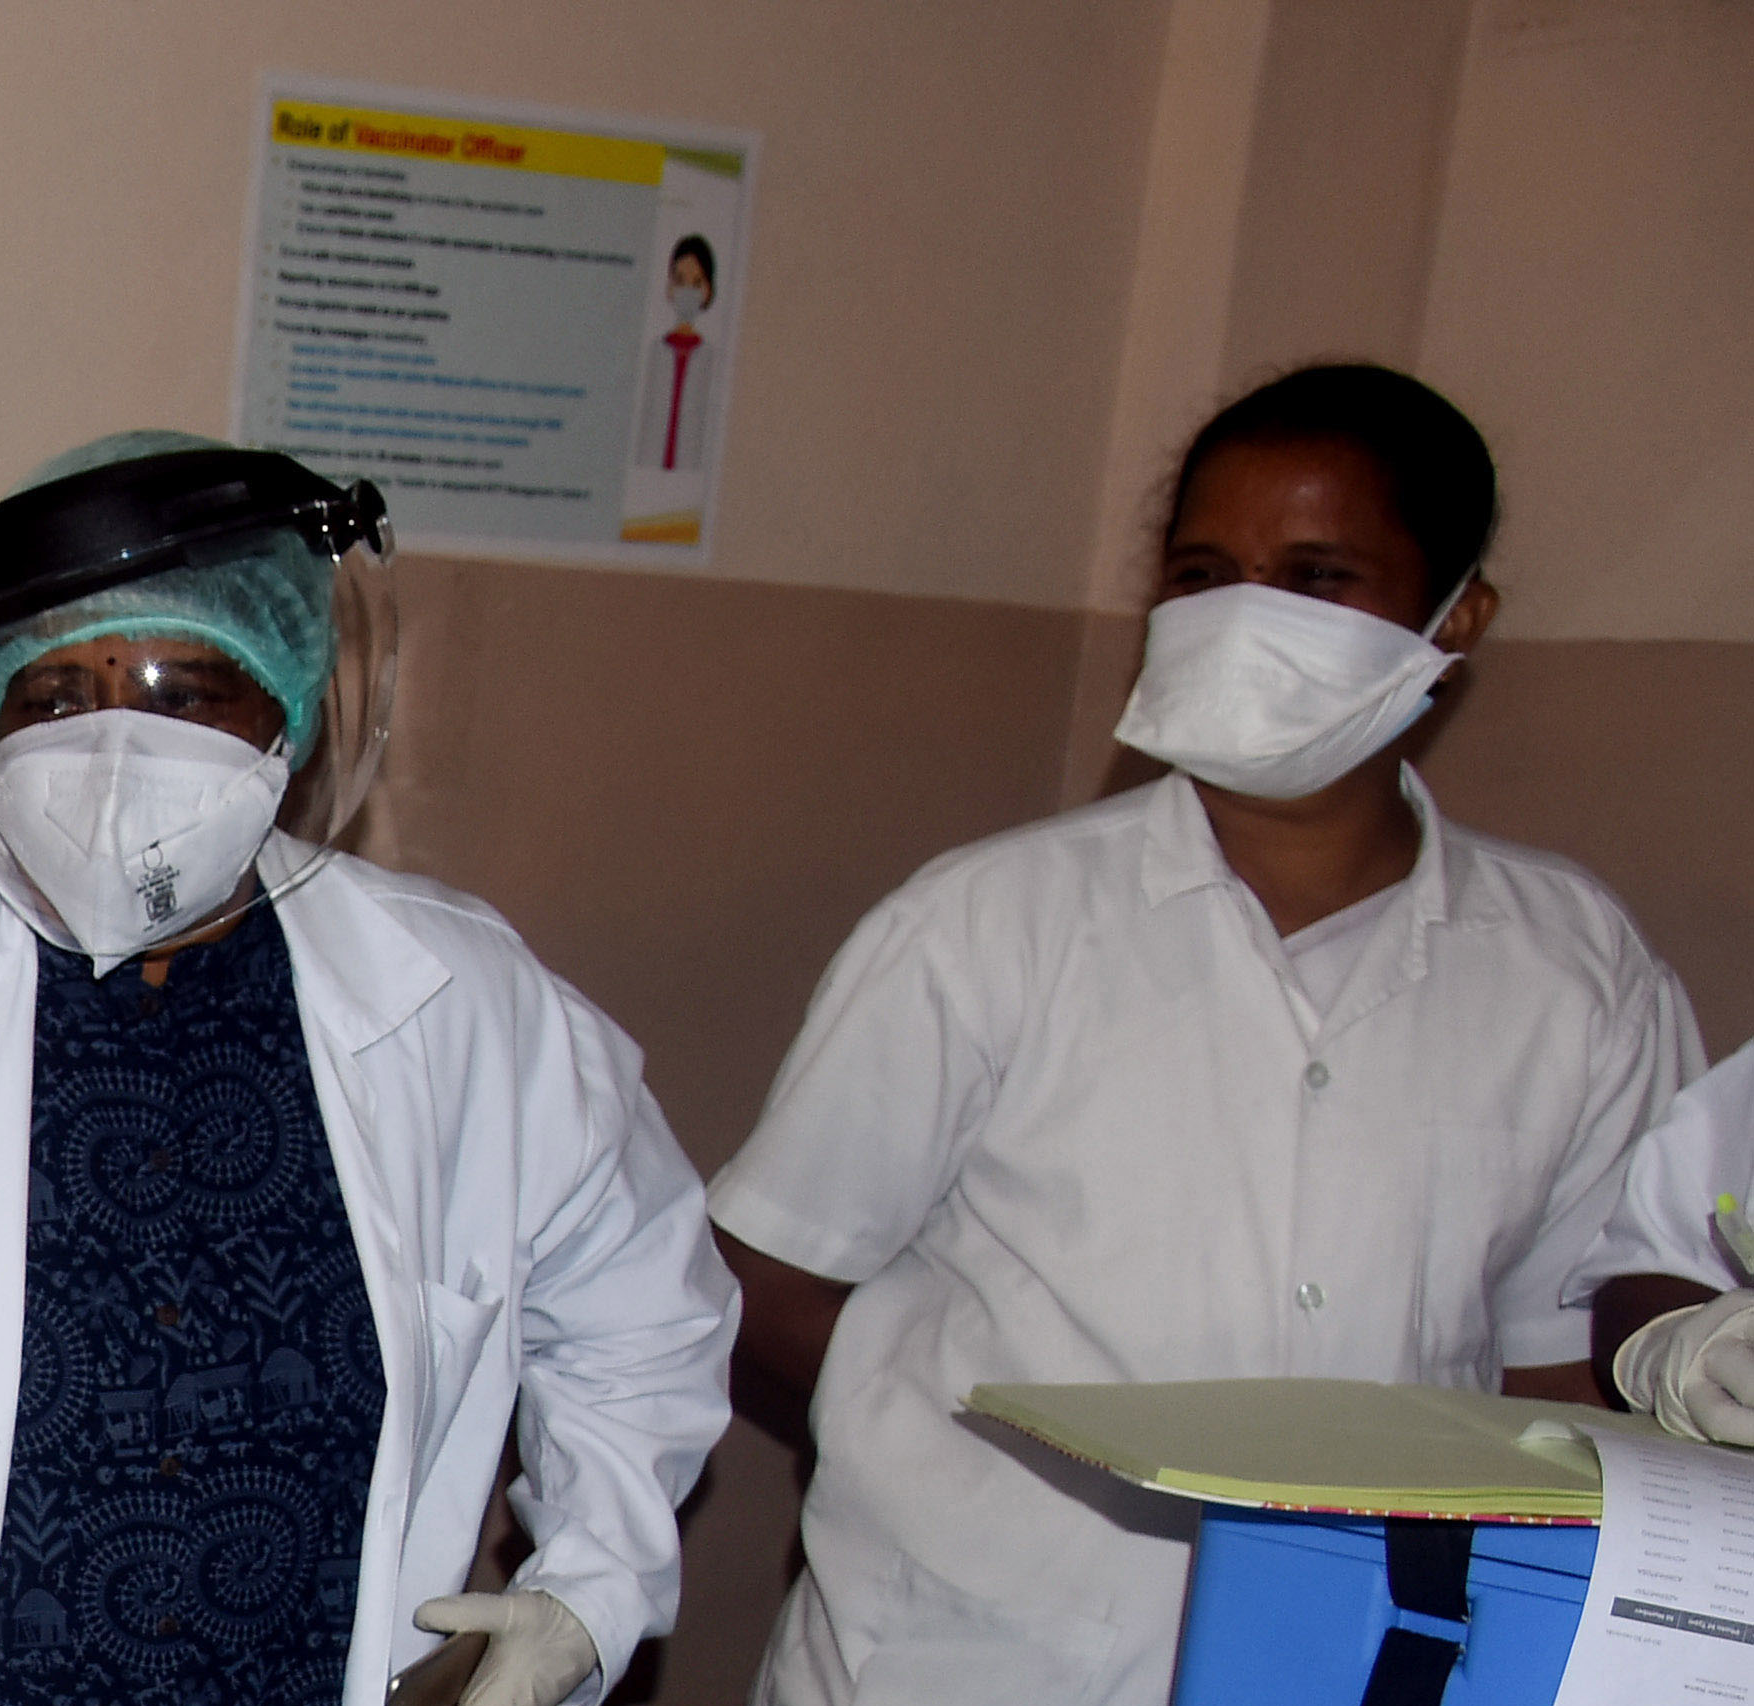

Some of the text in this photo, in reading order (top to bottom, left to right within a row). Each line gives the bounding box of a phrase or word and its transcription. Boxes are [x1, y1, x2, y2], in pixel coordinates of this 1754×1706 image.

[276, 109, 527, 164] Role of Vaccinator Officer
[1633, 1607, 1665, 1621] Number
